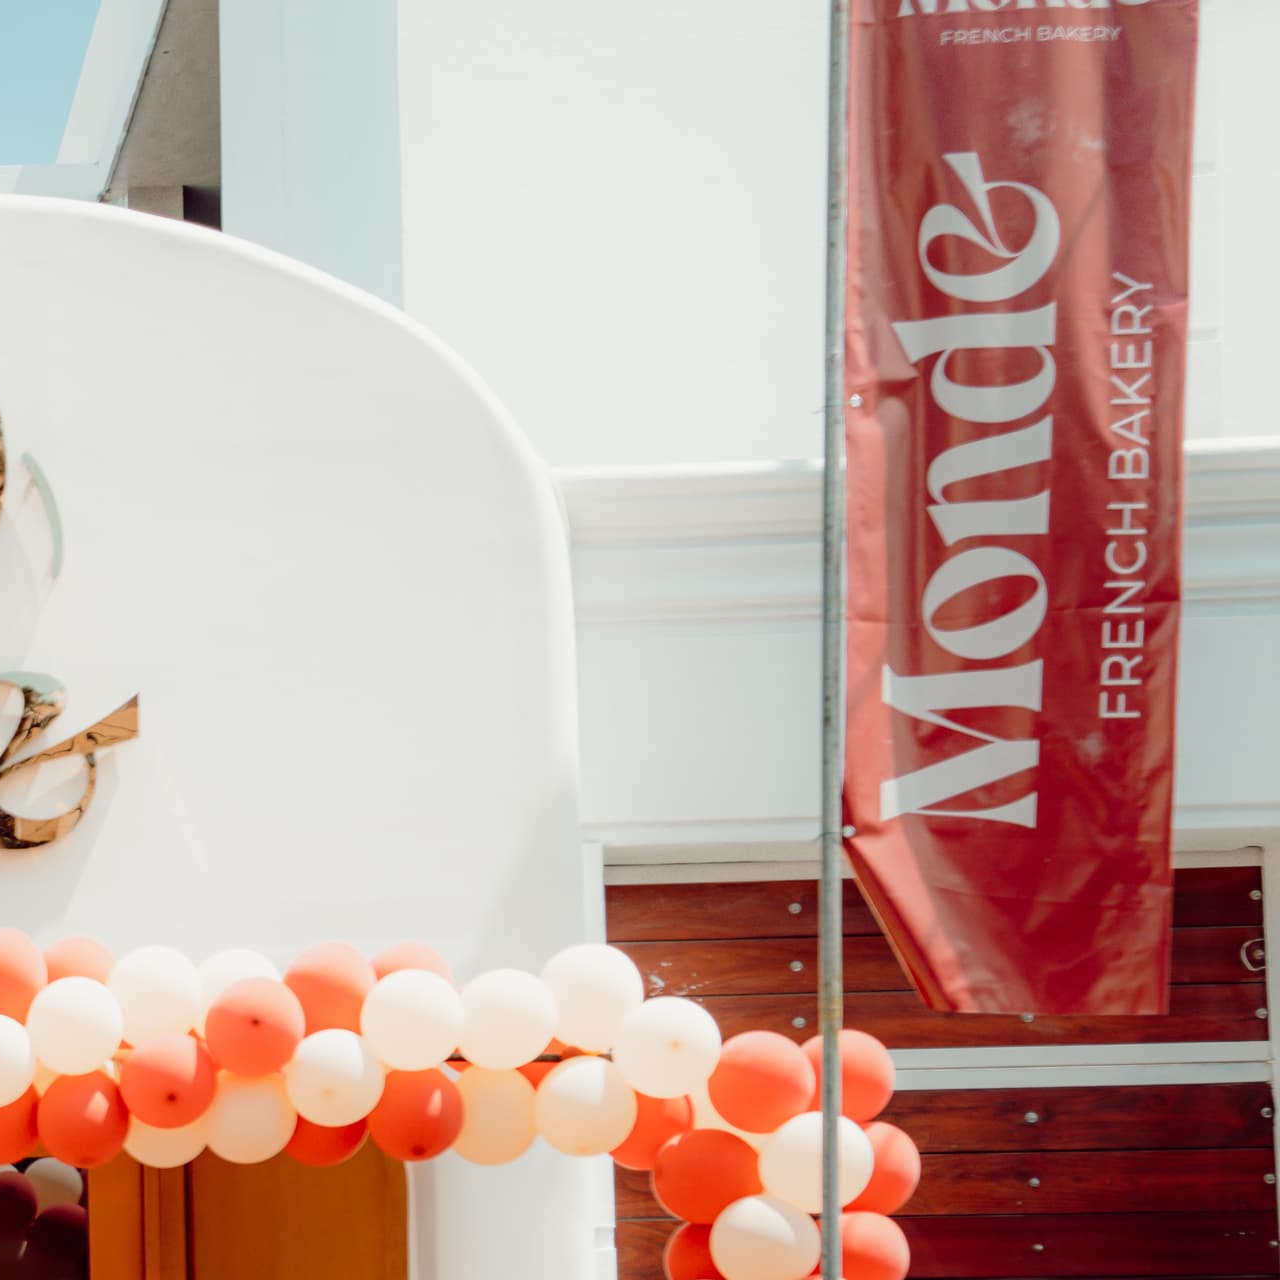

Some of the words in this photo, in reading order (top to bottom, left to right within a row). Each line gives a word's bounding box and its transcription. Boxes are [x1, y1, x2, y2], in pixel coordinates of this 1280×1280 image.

[939, 26, 1032, 46] FRENCH
[1036, 24, 1123, 43] BAKERY
[1107, 271, 1154, 481] BAKERY
[880, 151, 1061, 830] Monde
[1098, 501, 1149, 719] FRENCH
